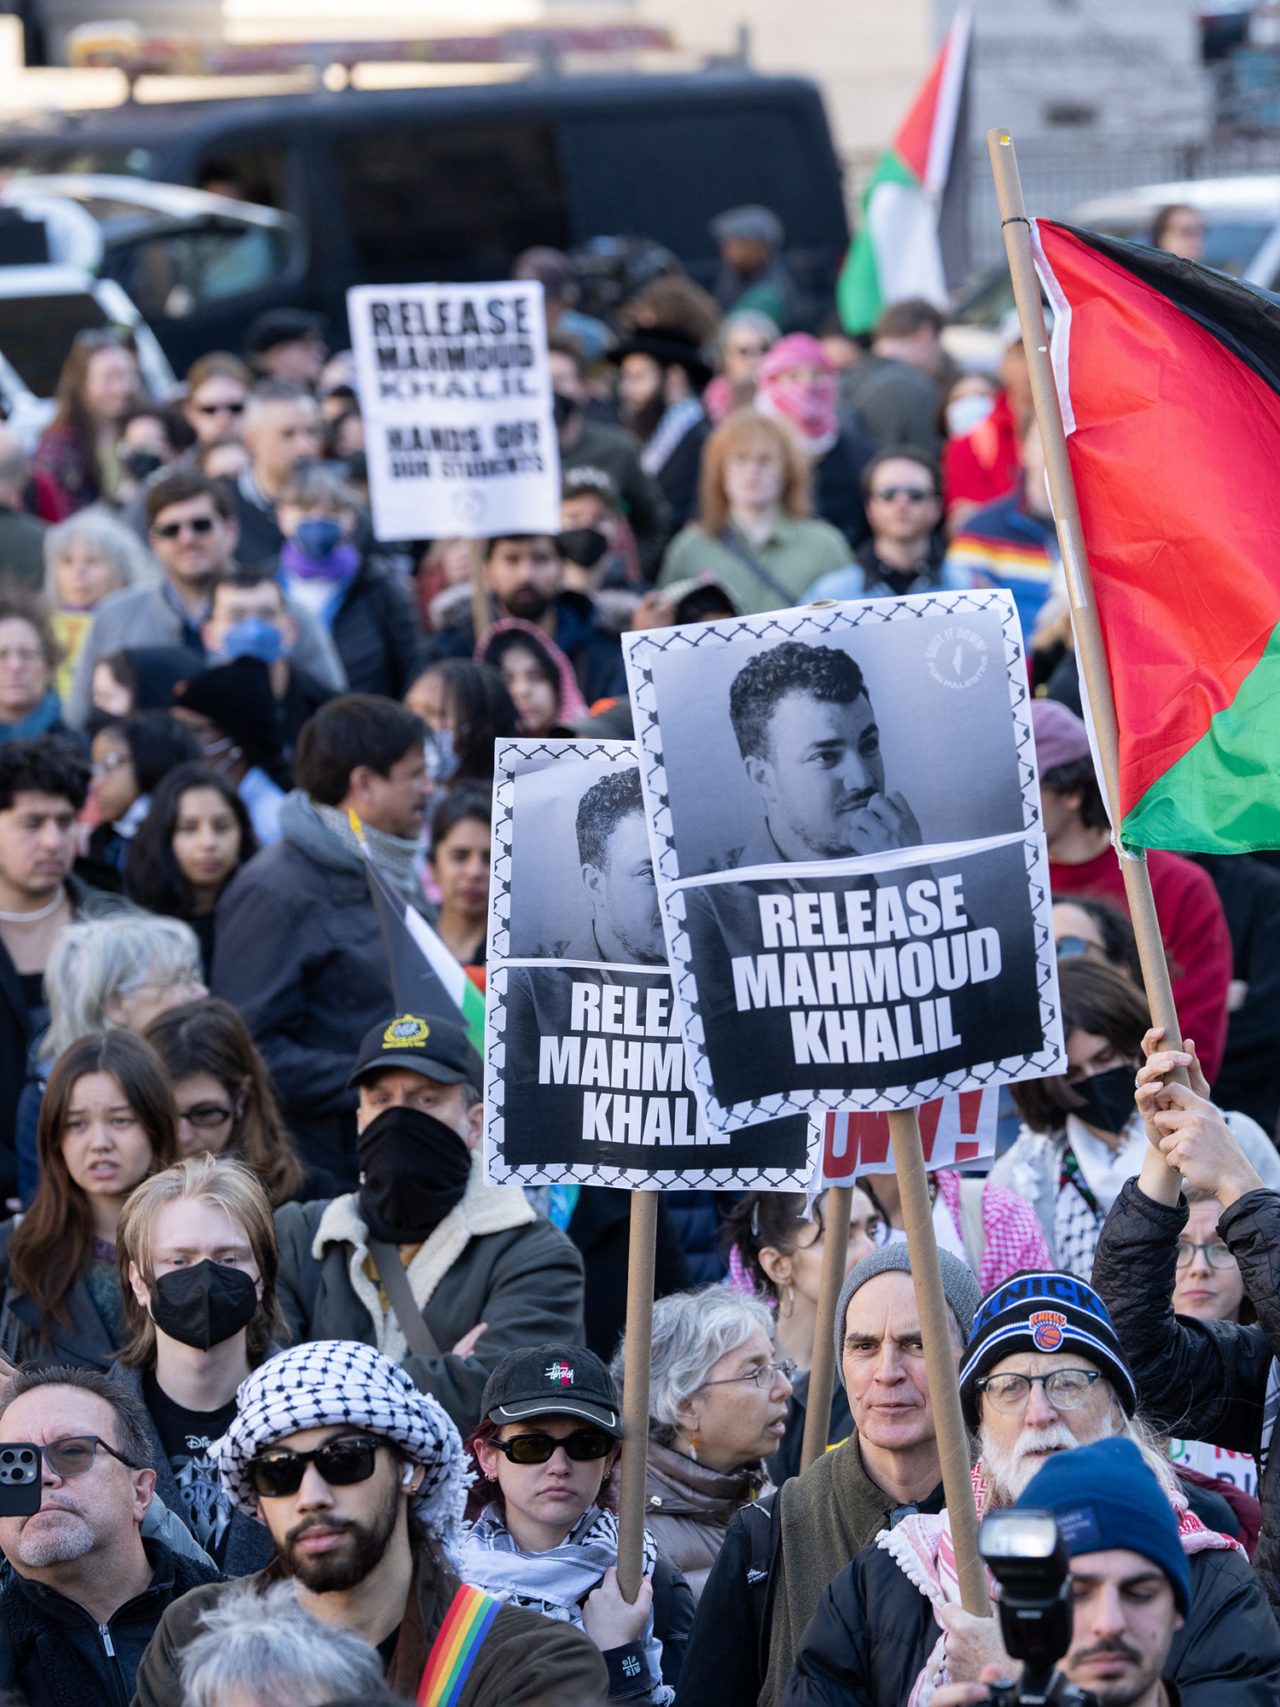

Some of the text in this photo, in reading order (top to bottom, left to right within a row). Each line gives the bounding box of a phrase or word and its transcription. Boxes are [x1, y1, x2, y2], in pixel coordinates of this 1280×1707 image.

[370, 298, 529, 336] RELEASE
[376, 344, 534, 371] MAHMOUD
[387, 420, 539, 452] HANDS OFF
[391, 460, 430, 478] OUR
[441, 456, 544, 478] STUDENTS
[758, 874, 968, 949] RELEASE
[731, 927, 1002, 1012] MAHMOUD
[570, 982, 683, 1037] RELE
[790, 996, 962, 1065] KHALIL
[538, 1036, 695, 1092] MAHM
[1030, 1311, 1066, 1328] KNICKS
